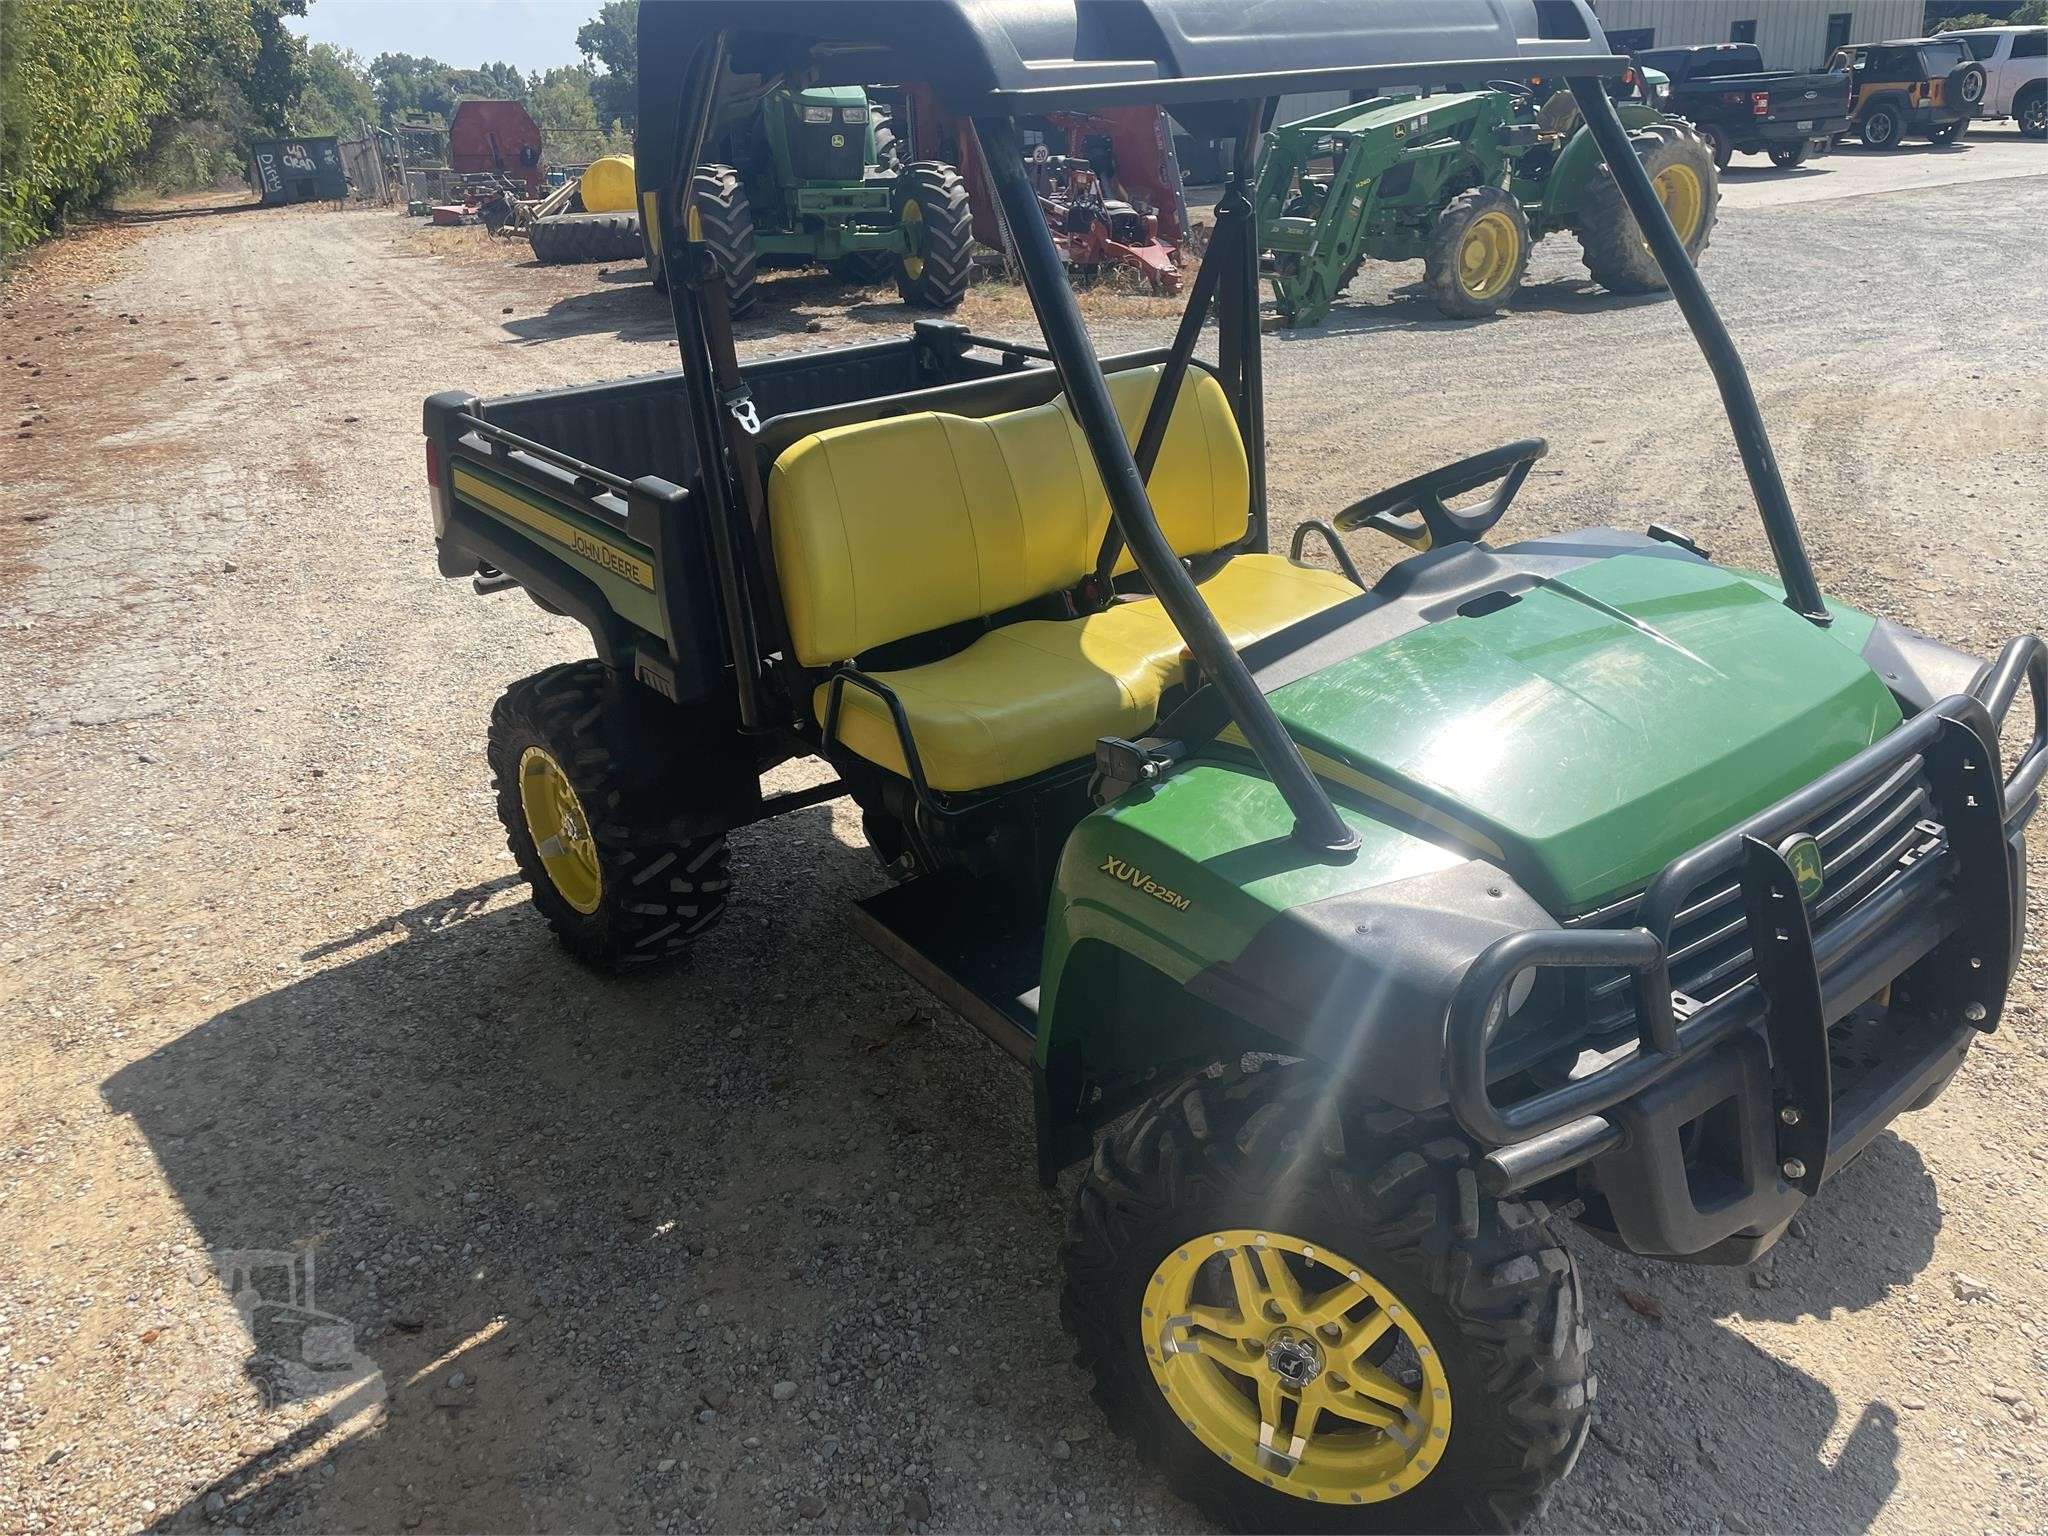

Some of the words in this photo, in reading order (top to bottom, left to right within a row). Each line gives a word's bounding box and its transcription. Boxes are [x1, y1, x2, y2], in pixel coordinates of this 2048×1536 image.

[261, 154, 282, 192] Dirty
[571, 530, 600, 563] JOHN
[602, 546, 640, 583] DEERE
[1100, 854, 1192, 912] XUV825M
